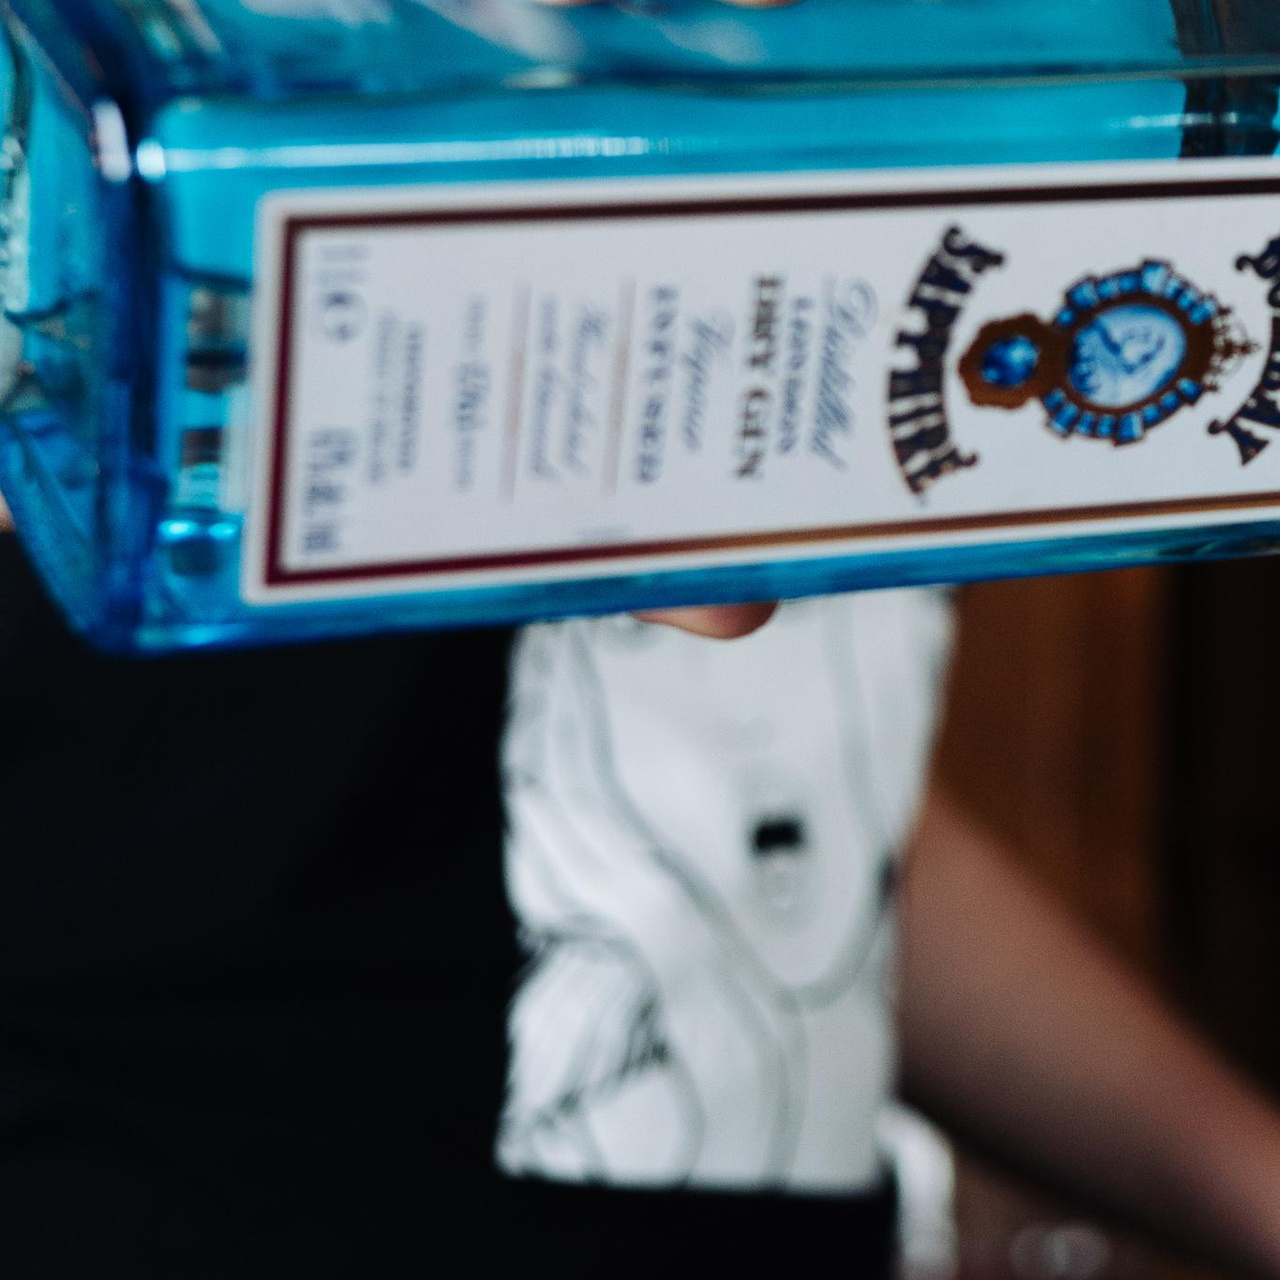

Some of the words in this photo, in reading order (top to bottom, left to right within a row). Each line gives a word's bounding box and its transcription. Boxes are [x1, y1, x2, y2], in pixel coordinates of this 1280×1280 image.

[747, 276, 786, 371] DRY
[889, 223, 1004, 496] SAPPHIRE
[734, 388, 773, 482] GIN
